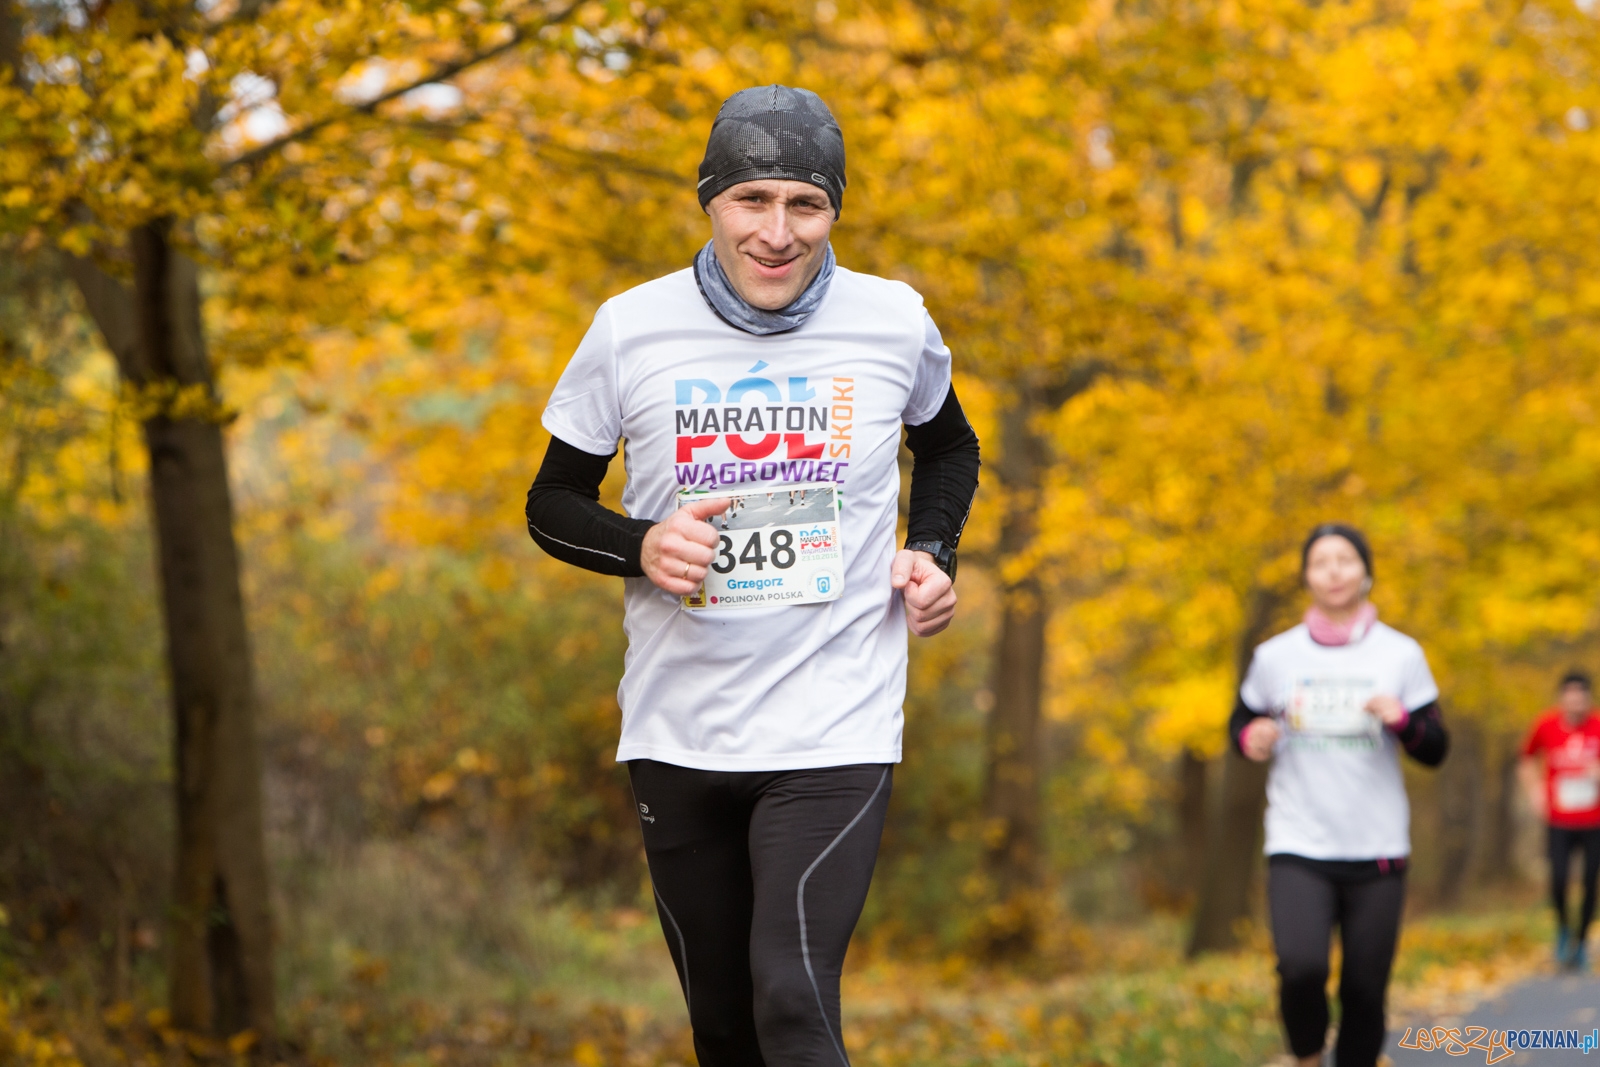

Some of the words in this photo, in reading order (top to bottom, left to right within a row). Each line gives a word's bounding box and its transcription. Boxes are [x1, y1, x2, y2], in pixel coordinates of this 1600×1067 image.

[675, 406, 829, 435] MARATON
[829, 376, 854, 459] SKOKI
[674, 460, 849, 490] WĄGROWIEC
[800, 535, 832, 543] MARATON
[711, 529, 796, 575] 348
[802, 552, 838, 561] 23.10.2016
[727, 578, 783, 590] Grzegorz
[719, 594, 766, 603] POLINOVA
[767, 591, 804, 600] POLSKA
